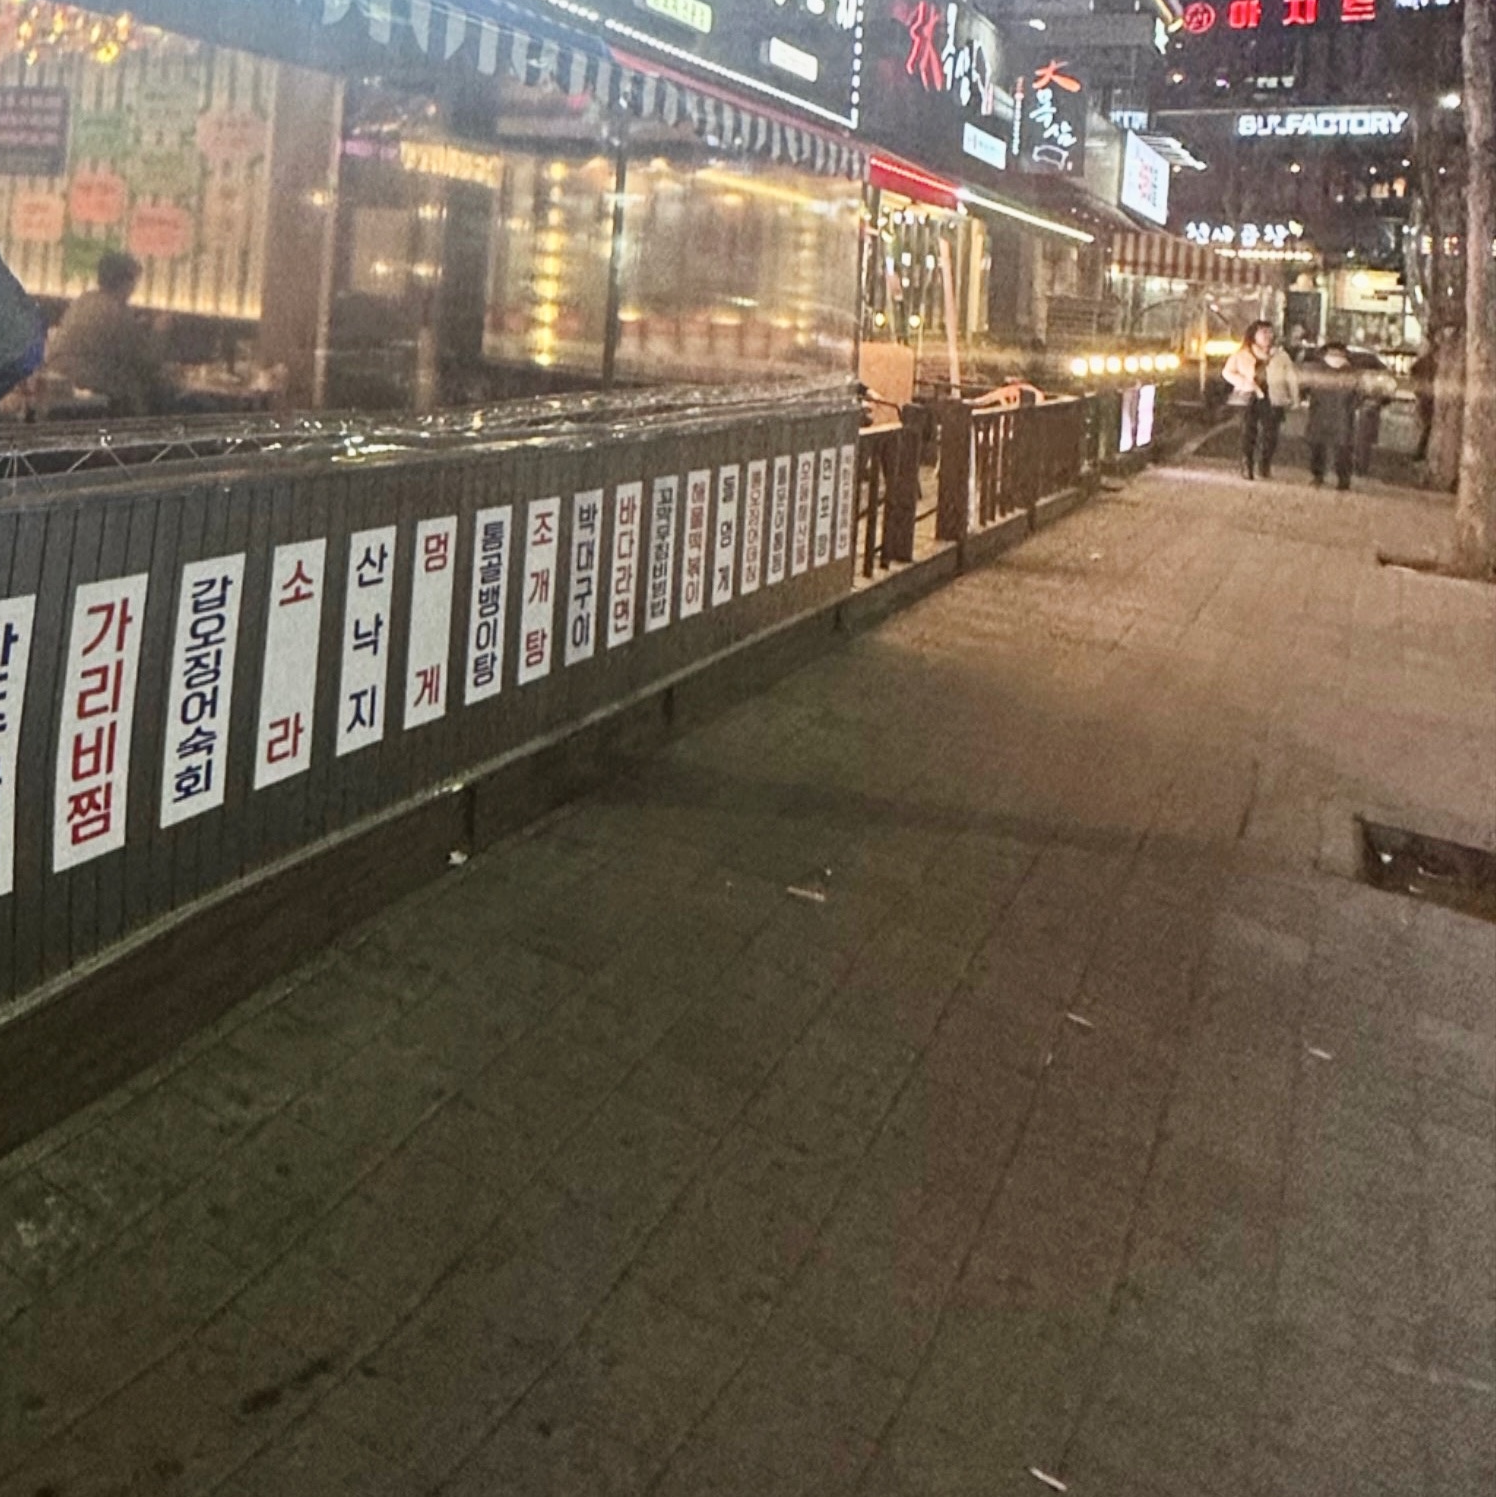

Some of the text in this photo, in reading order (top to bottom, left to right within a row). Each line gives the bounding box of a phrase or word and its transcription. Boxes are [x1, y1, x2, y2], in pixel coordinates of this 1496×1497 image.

[172, 574, 234, 804] 갑오징어숙회
[346, 543, 388, 735] 산낙지
[525, 511, 556, 669] 조개탕
[67, 596, 133, 847] 가리비찜
